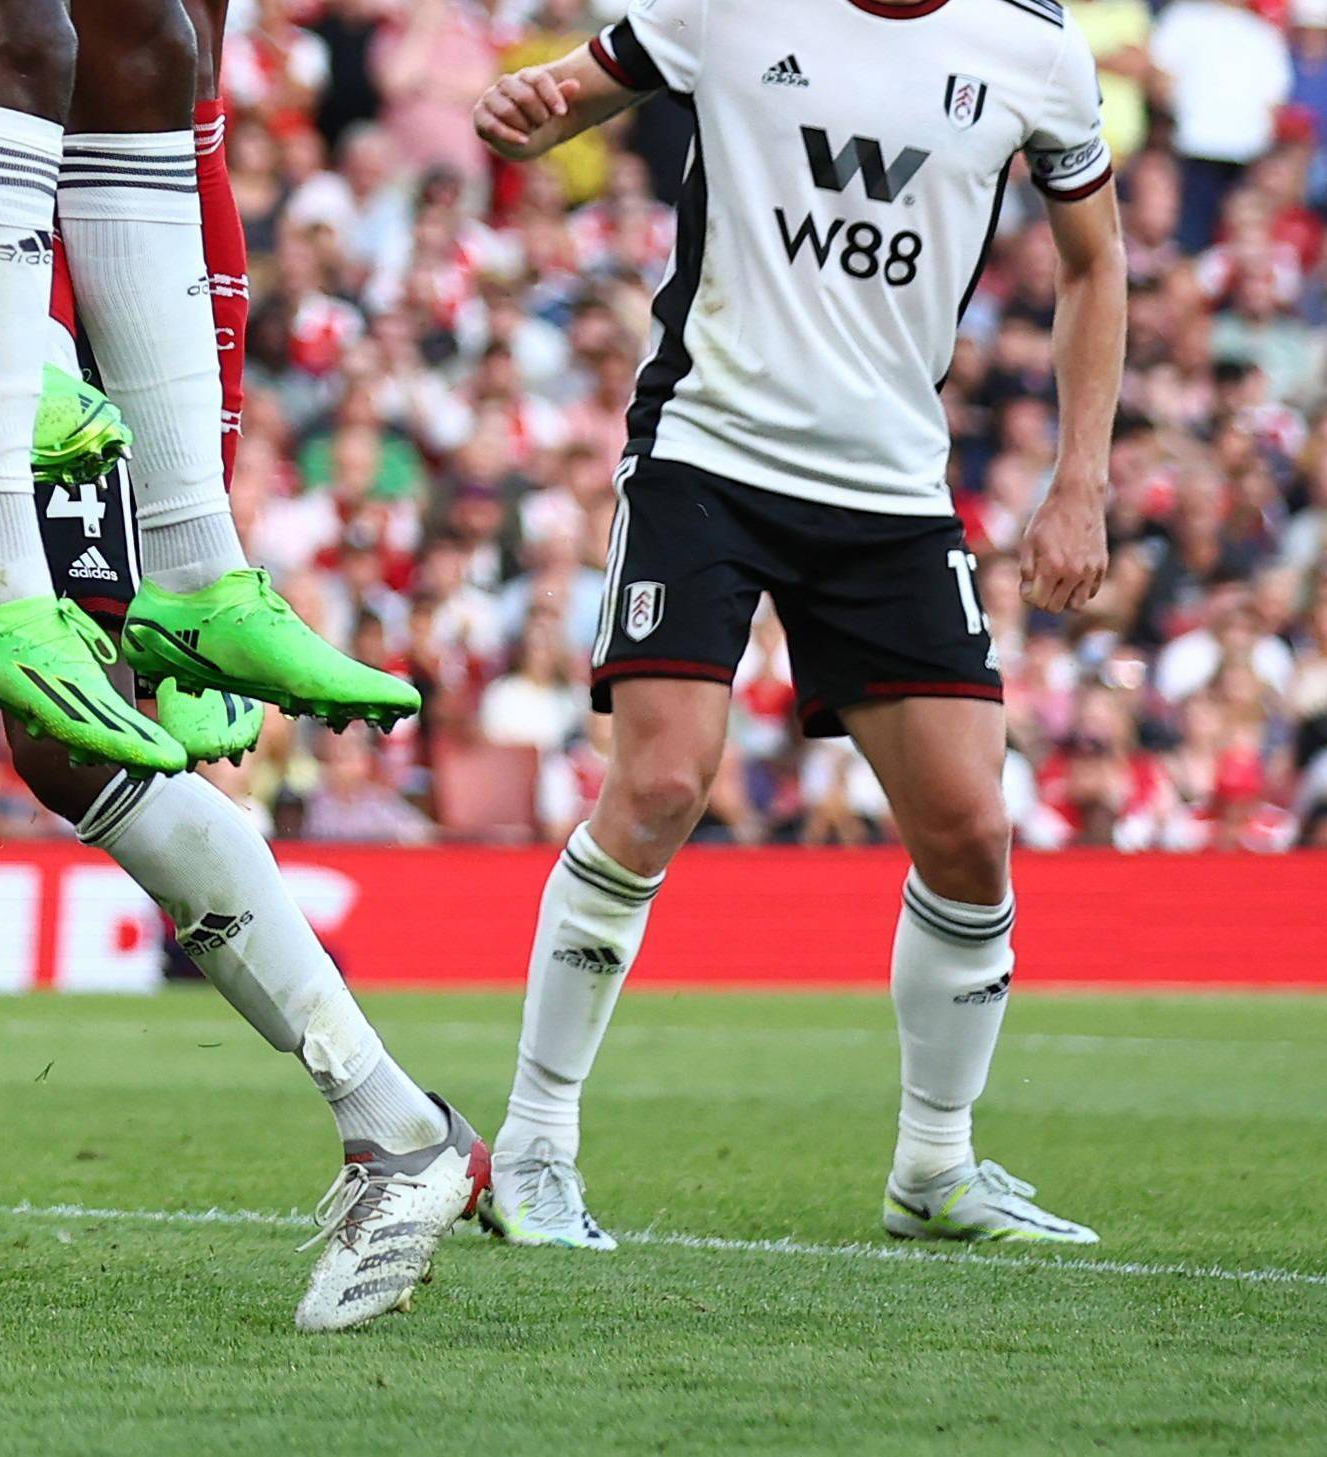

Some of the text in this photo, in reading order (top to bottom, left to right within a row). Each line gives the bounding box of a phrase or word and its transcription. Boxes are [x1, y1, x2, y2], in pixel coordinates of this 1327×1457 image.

[773, 206, 923, 287] W88
[68, 565, 119, 583] adidas
[947, 548, 990, 635] 1
